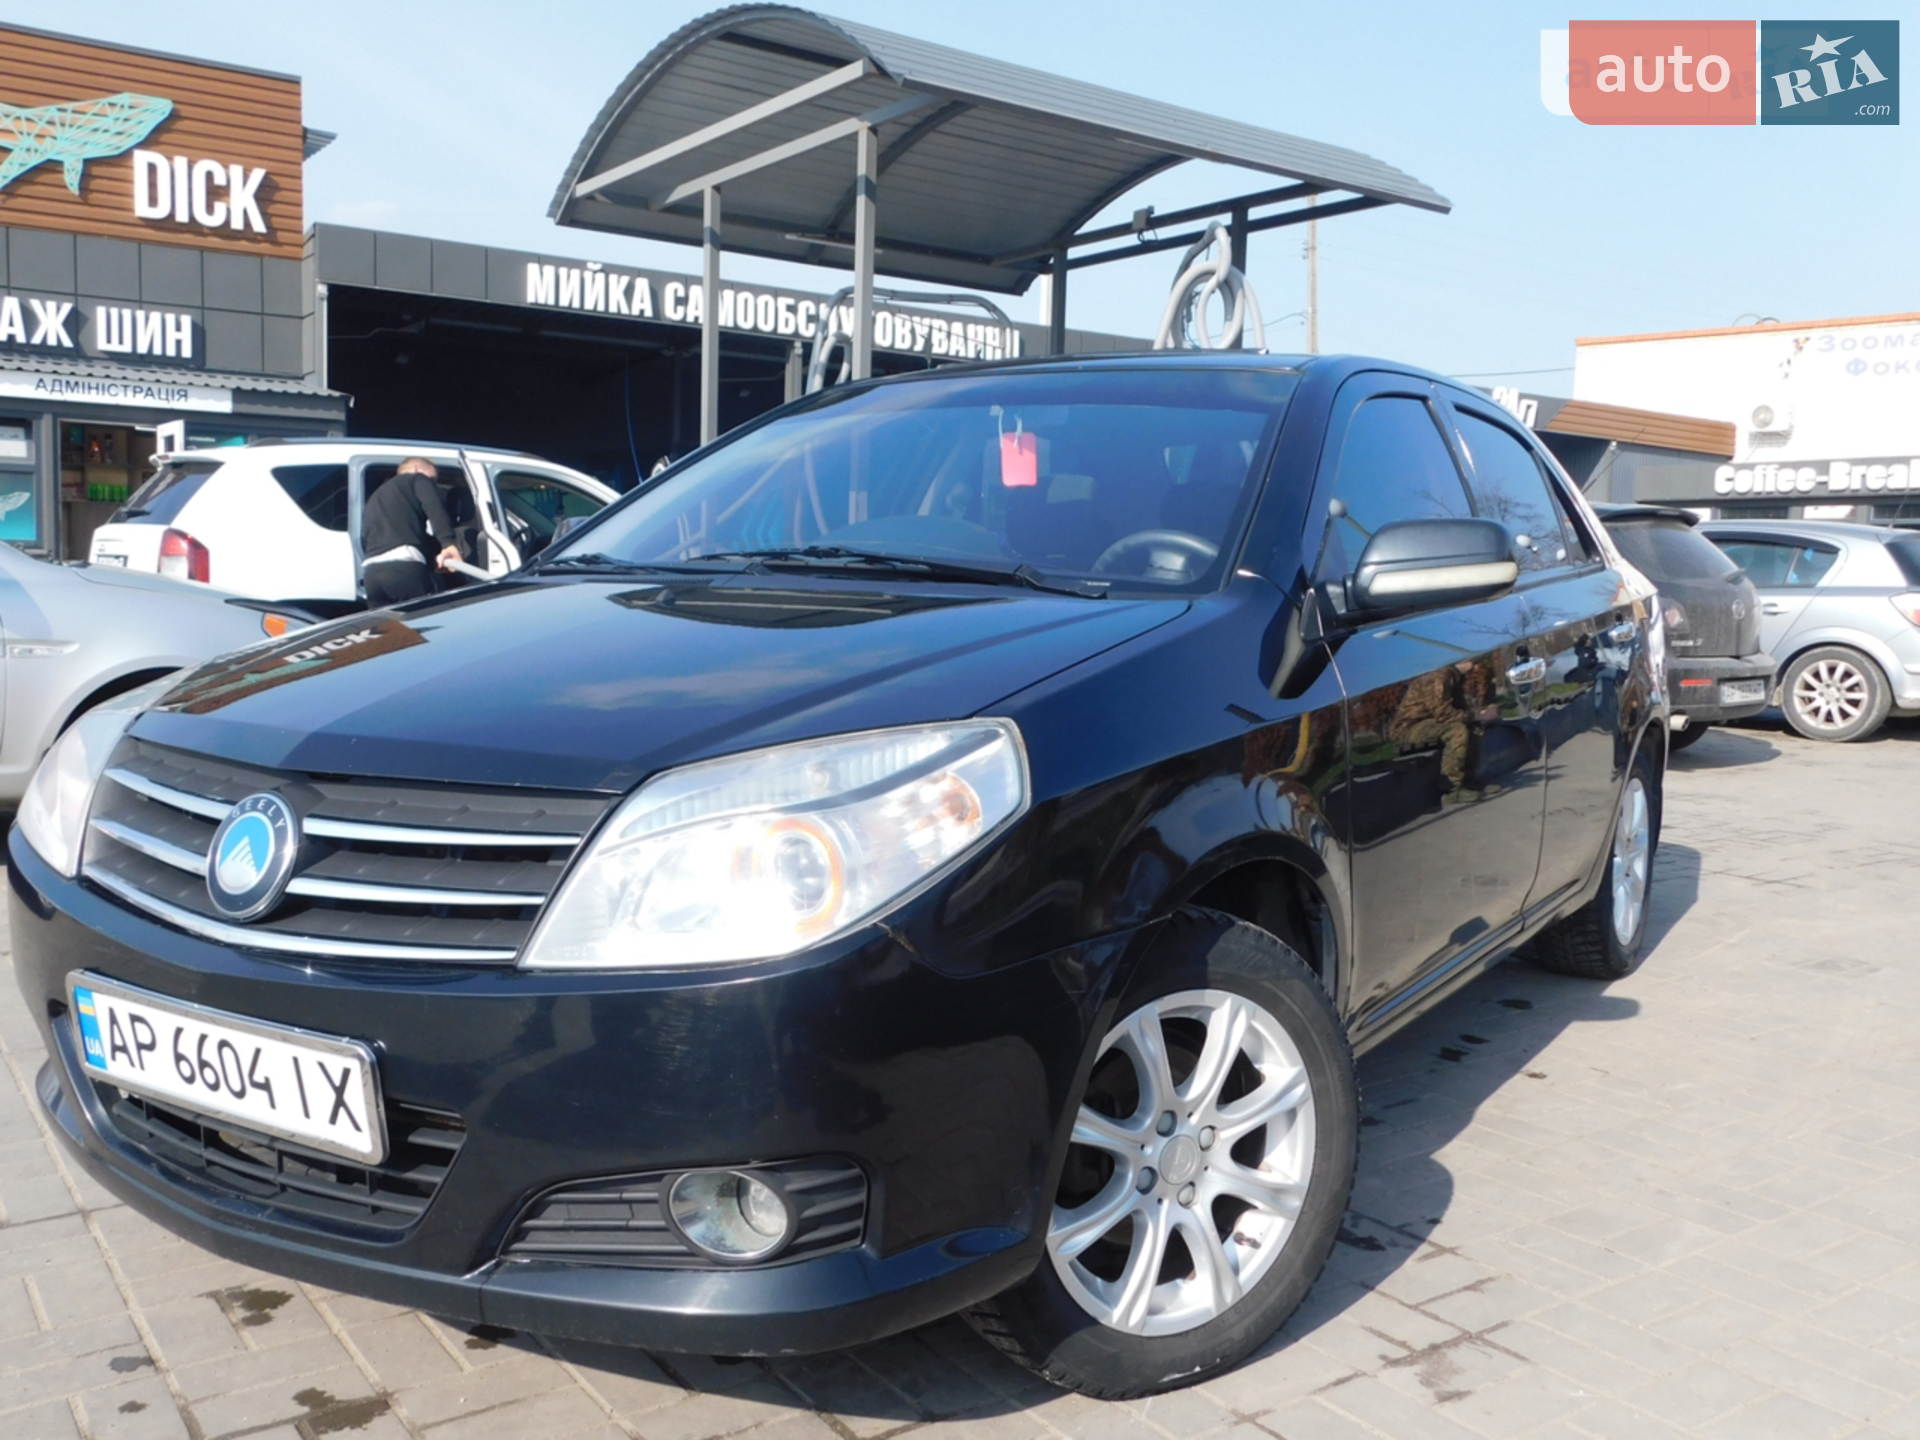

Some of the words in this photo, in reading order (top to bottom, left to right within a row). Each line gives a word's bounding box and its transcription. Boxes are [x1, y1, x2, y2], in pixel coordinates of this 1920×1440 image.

[133, 149, 267, 234] DICK
[526, 262, 653, 318] МИЙКА
[0, 296, 75, 348] АЖ
[96, 305, 193, 359] ШИН
[34, 377, 188, 404] АДМІНІСТРАЦІЯ
[231, 798, 287, 829] GEELY
[84, 1036, 104, 1058] UA
[108, 1006, 157, 1071] AP
[173, 1026, 277, 1110] 6604
[292, 1055, 363, 1133] IX
